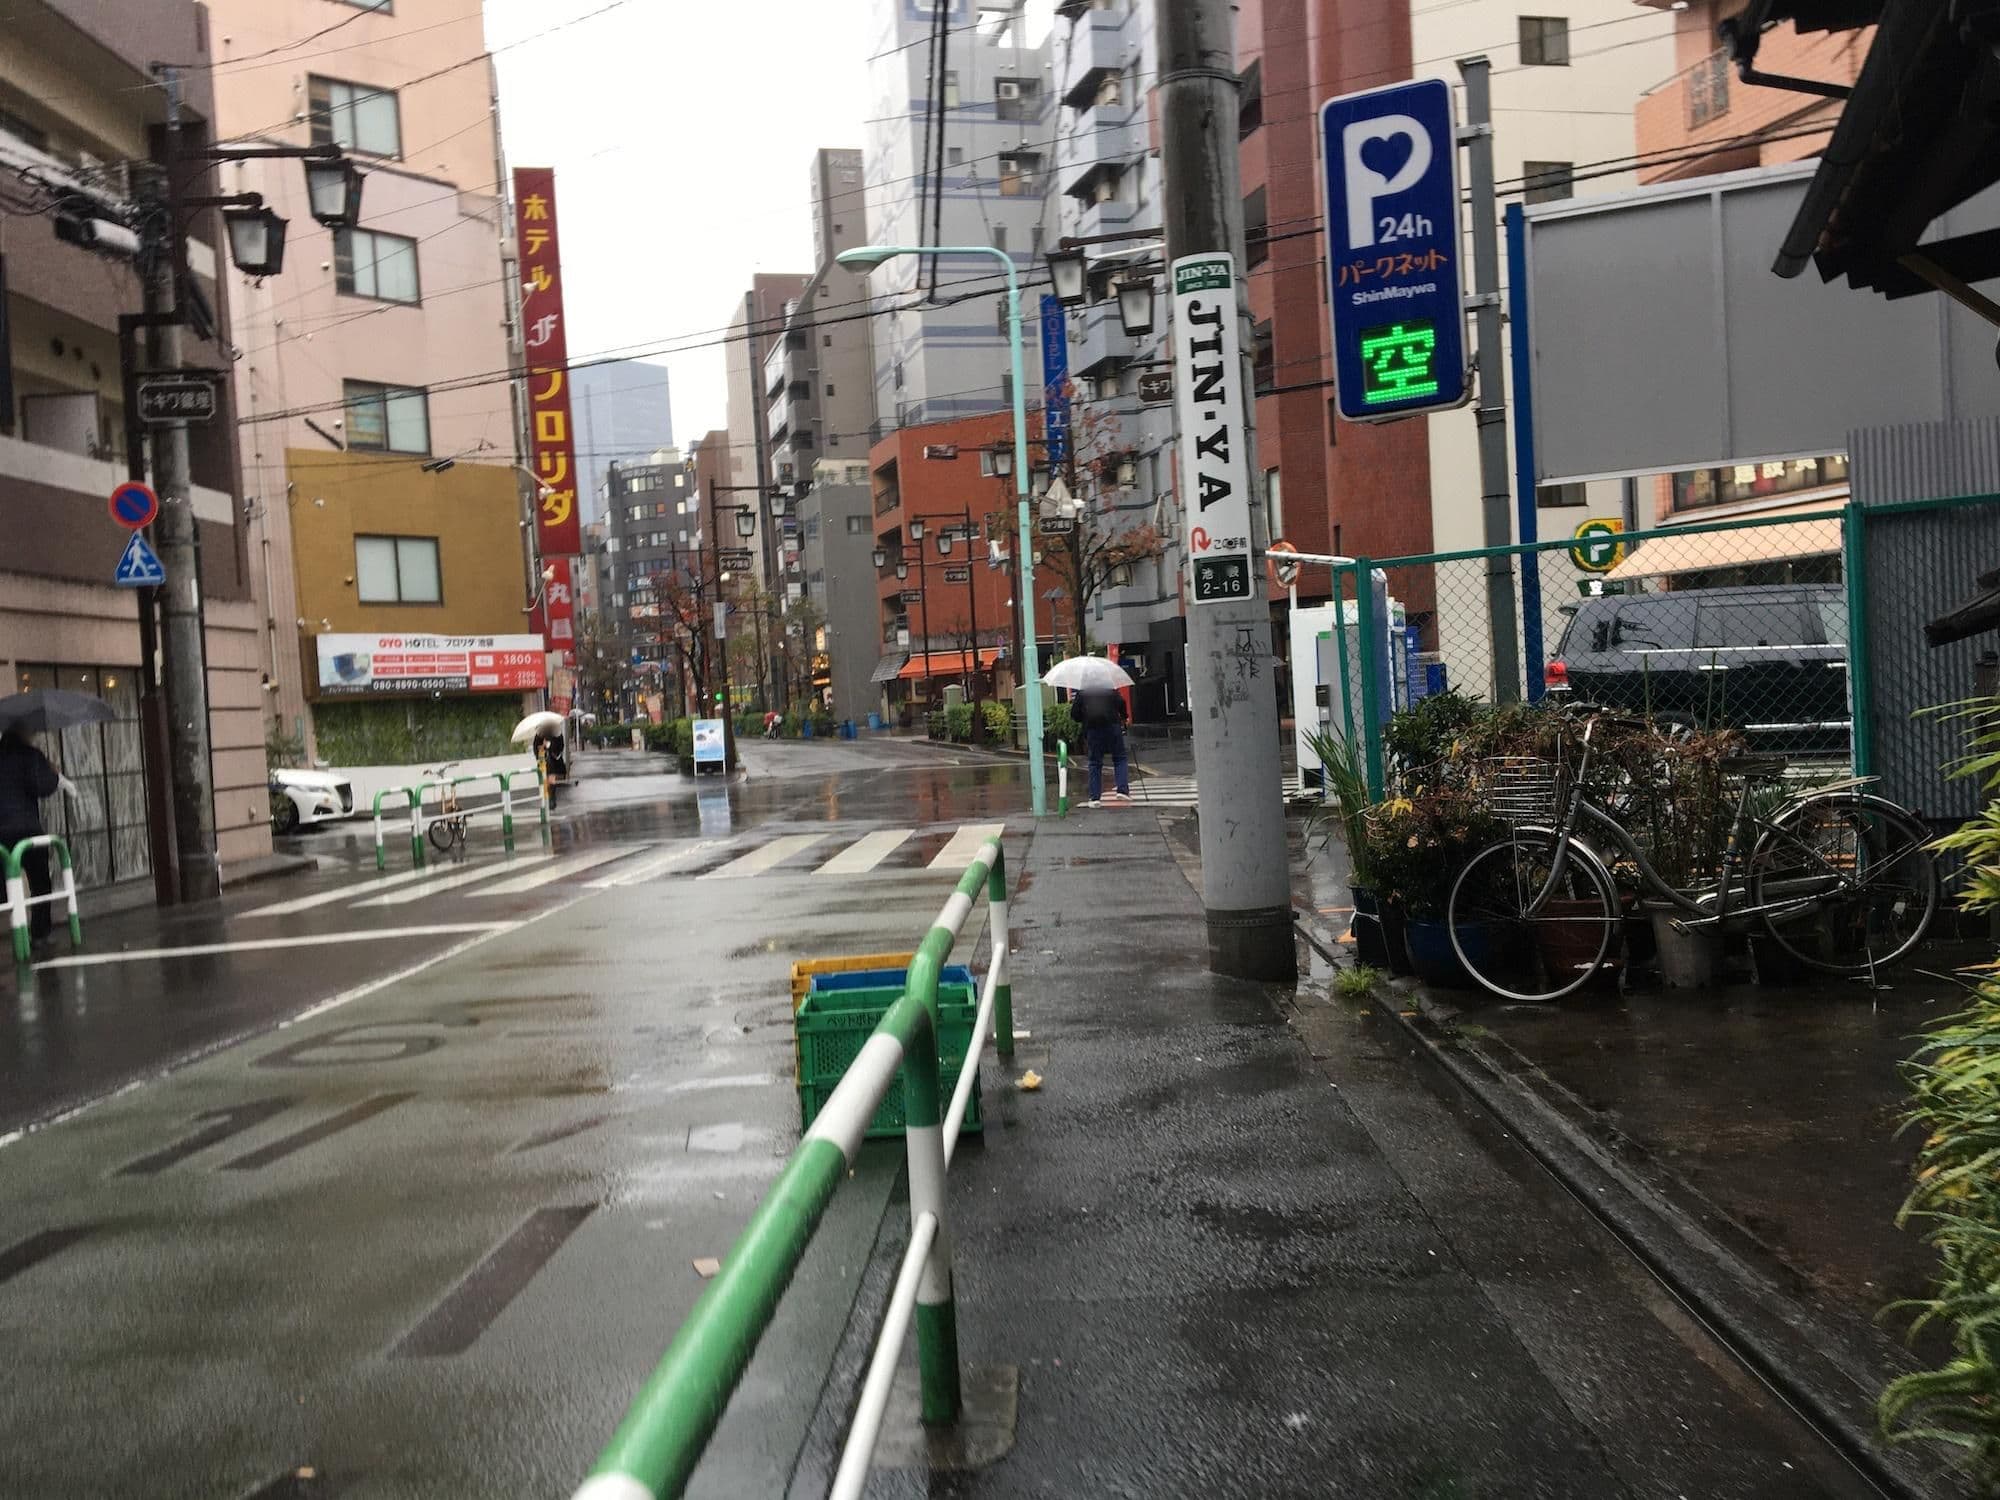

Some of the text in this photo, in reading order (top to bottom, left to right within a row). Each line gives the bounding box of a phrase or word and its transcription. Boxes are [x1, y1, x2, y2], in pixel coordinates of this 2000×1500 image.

[523, 194, 552, 291] ホテル
[1379, 213, 1433, 244] 24h
[1178, 264, 1229, 281] JIN-YA
[1339, 249, 1448, 288] パークネット
[1352, 281, 1437, 306] ShinMaywa
[1362, 325, 1438, 404] 空
[534, 367, 575, 527] フロリダ
[1203, 579, 1241, 595] 2-16
[379, 638, 403, 649] OYO
[405, 638, 438, 649] HOTEL
